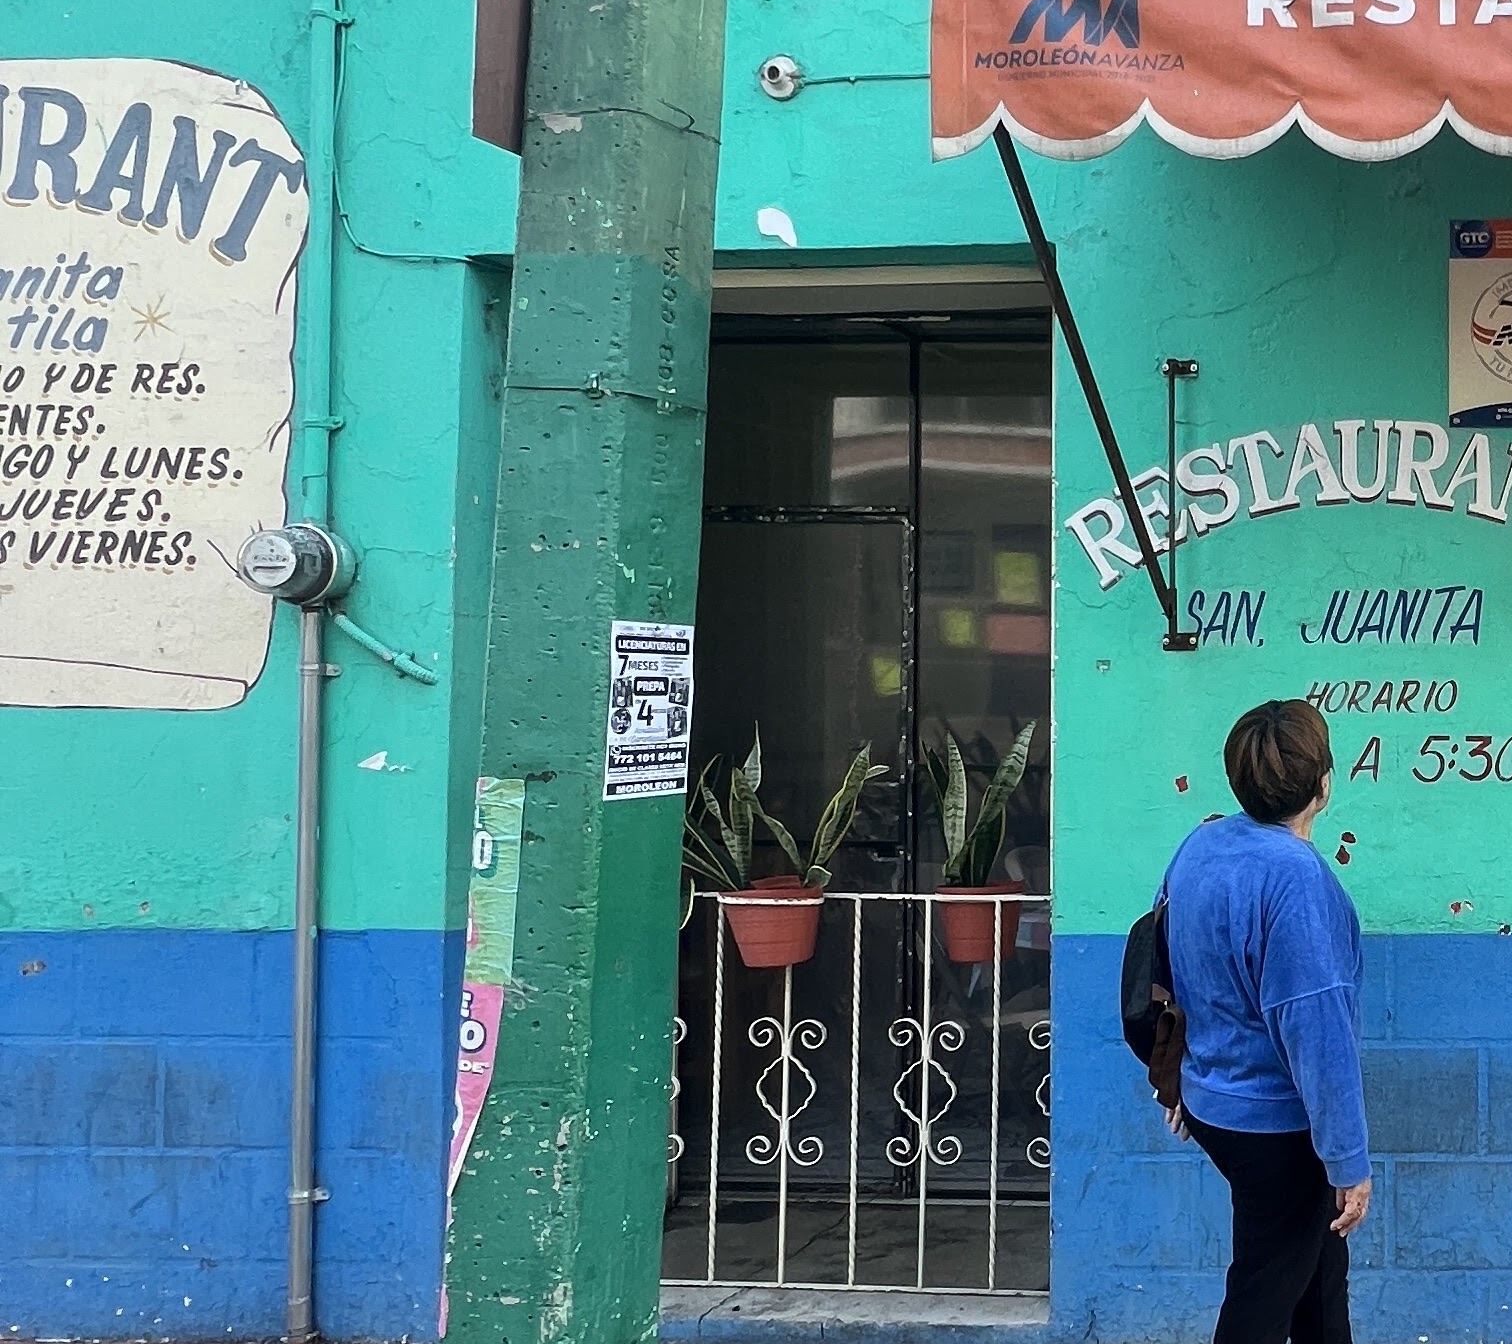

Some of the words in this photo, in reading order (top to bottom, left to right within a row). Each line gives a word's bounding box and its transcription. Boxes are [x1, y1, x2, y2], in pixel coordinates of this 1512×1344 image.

[0, 84, 305, 262] RANT
[130, 363, 206, 395] RES.
[0, 444, 55, 479] GO
[66, 444, 91, 480] Y
[100, 446, 244, 481] LUNES.
[0, 488, 171, 522] JUEVES.
[29, 529, 197, 567] VIERNES.
[1299, 585, 1484, 647] JUANITA
[618, 654, 630, 677] 7
[628, 660, 659, 672] MESES
[636, 699, 654, 727] 4
[1305, 679, 1459, 714] HORARIO
[1350, 736, 1382, 783] A
